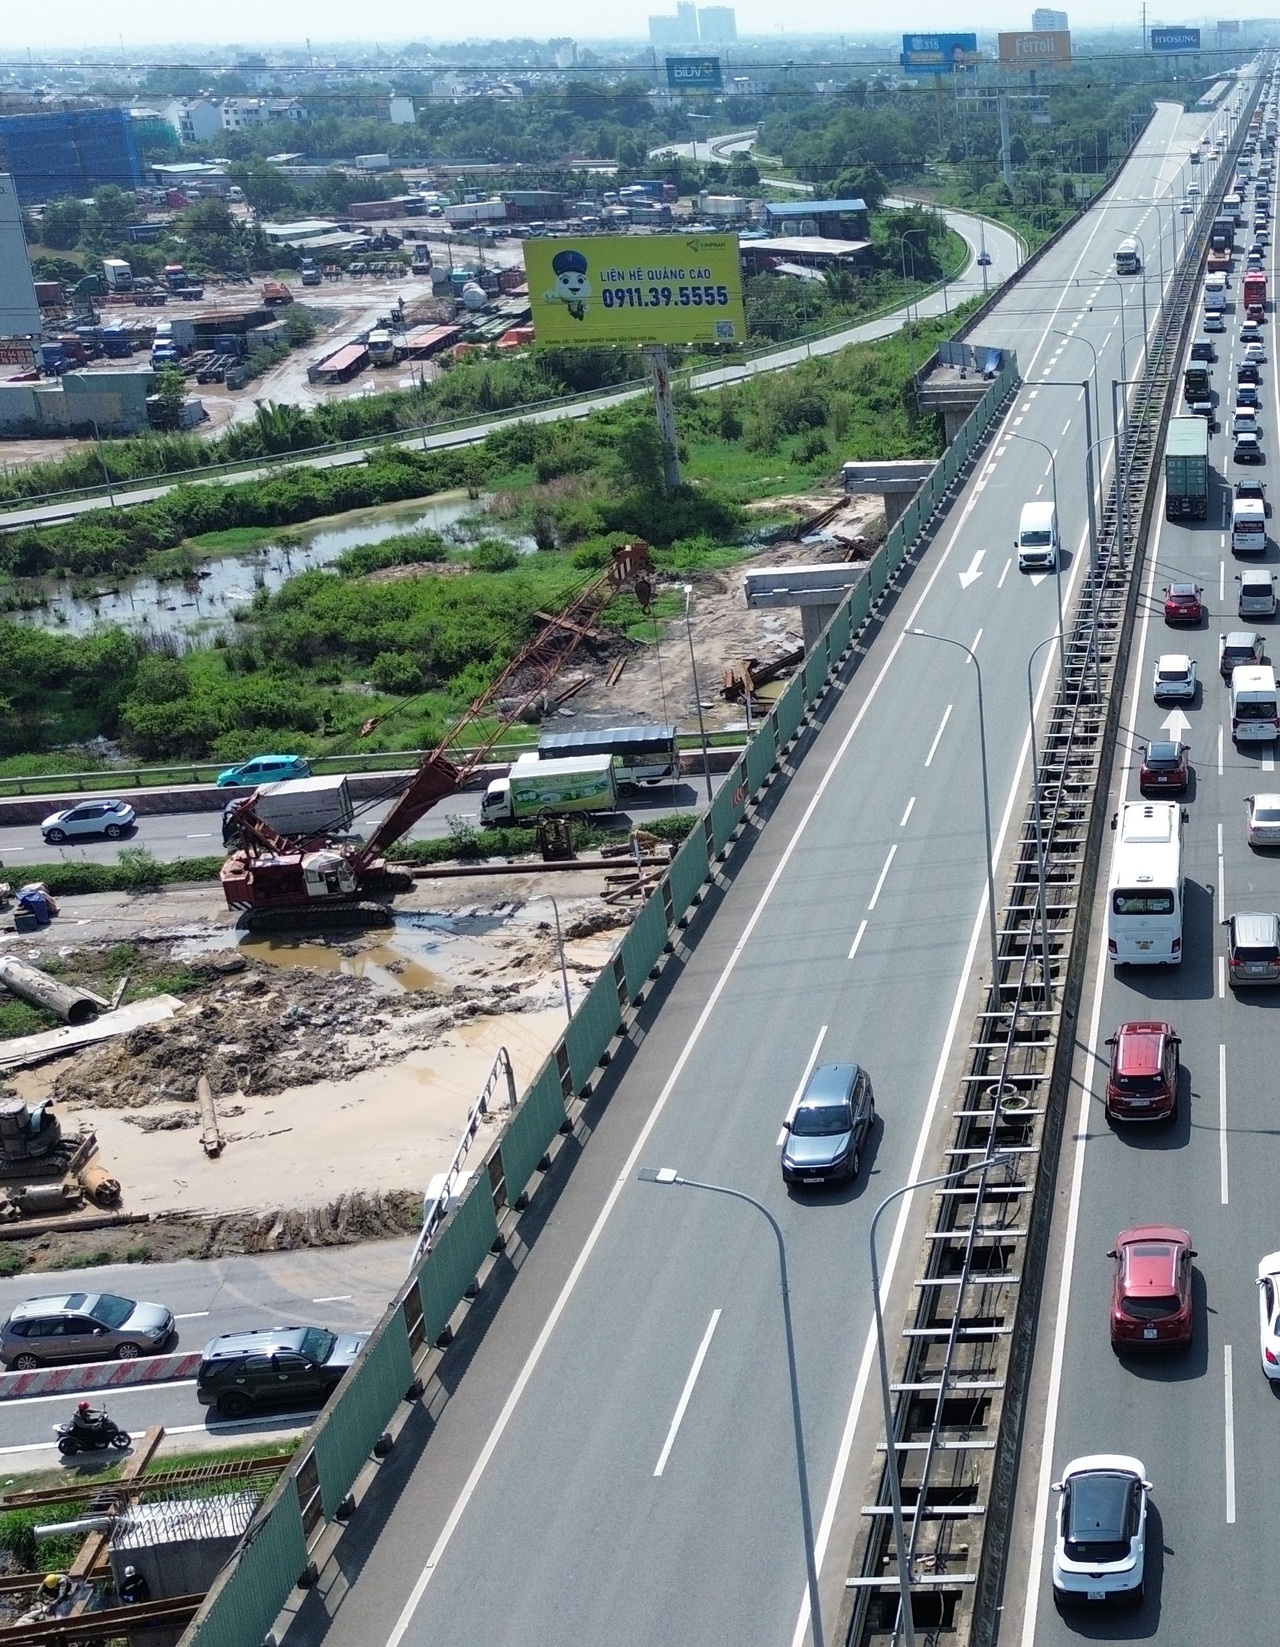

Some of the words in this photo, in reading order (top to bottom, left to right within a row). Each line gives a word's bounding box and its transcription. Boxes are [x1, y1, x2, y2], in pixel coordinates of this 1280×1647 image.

[924, 41, 940, 50] 315
[1015, 37, 1055, 56] Ferroli
[1155, 35, 1197, 43] HYOSUNG
[673, 65, 701, 78] BIDV
[600, 268, 625, 283] LIÊN
[629, 267, 643, 284] HỆ
[647, 266, 685, 282] QUẢNG
[689, 266, 711, 280] CÁO
[602, 285, 729, 309] 0911.39.5555
